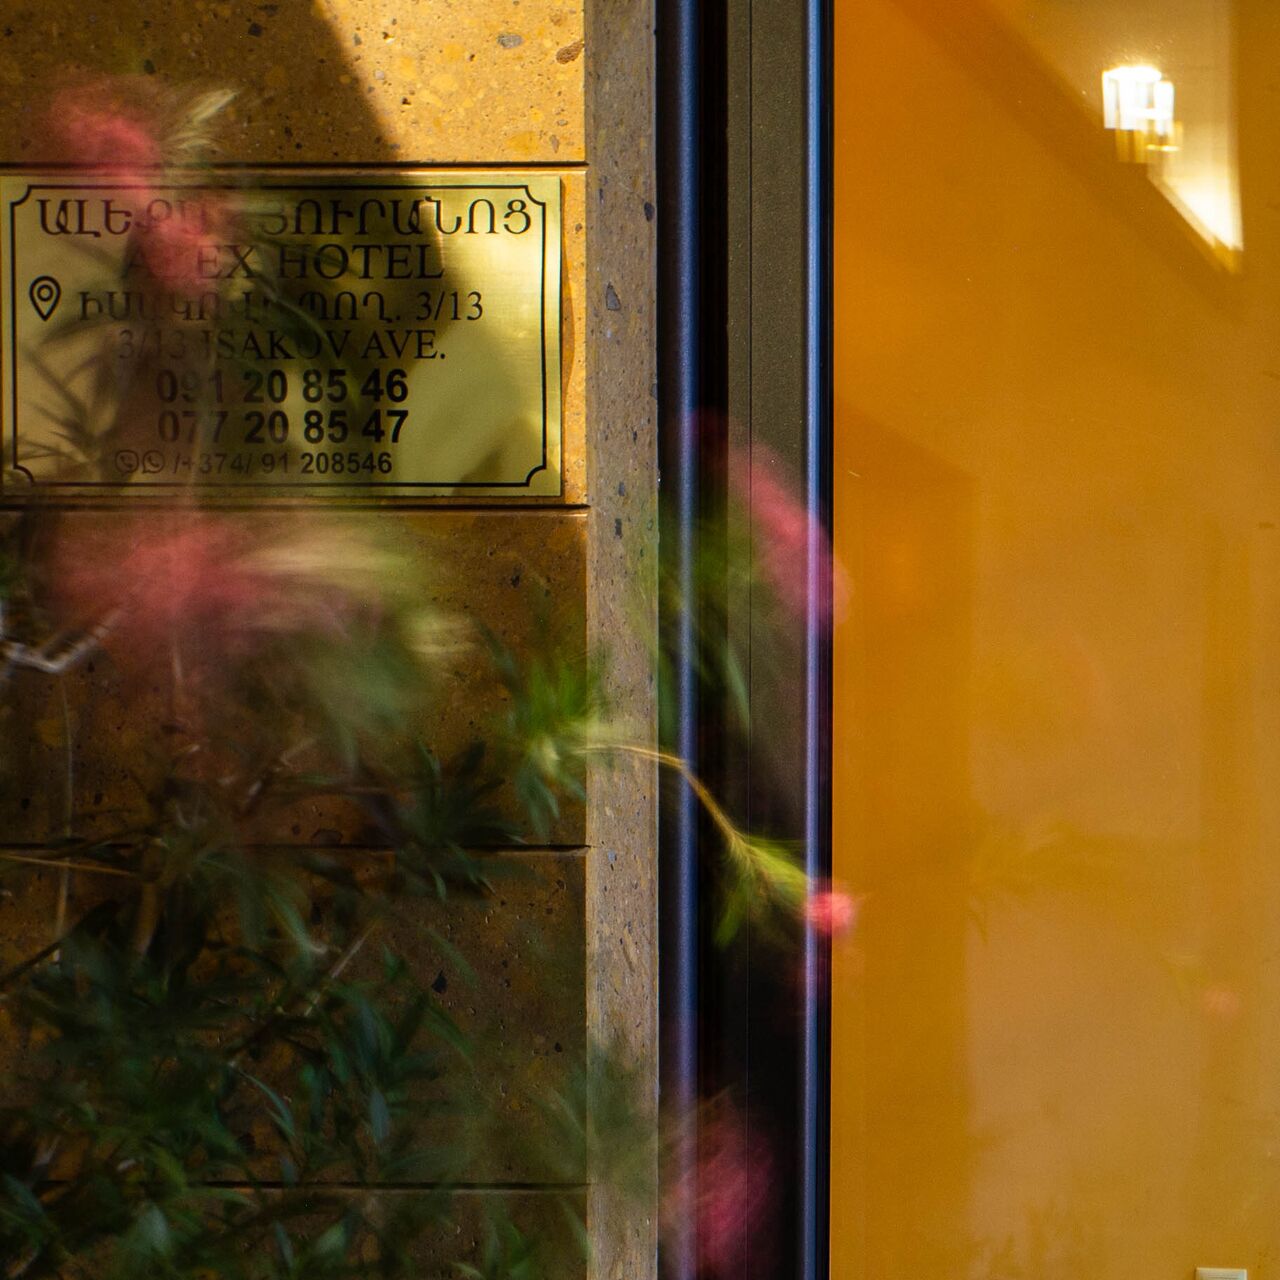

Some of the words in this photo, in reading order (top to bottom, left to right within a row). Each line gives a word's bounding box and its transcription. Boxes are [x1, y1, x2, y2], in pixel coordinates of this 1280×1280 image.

[226, 196, 532, 235] ՅՈՒՐԱՆՈՑ
[278, 244, 445, 279] HOTEL
[416, 290, 484, 321] 3/13
[200, 329, 350, 360] ISAKOV
[361, 330, 446, 360] AVE.
[156, 369, 223, 403] 091
[242, 369, 288, 403] 20
[302, 369, 348, 403] 85
[360, 369, 408, 402] 46
[158, 410, 229, 443] 077
[244, 411, 289, 444] 20
[303, 410, 348, 444] 85
[361, 410, 409, 443] 47
[261, 453, 289, 474] 91
[301, 452, 392, 474] 208546
